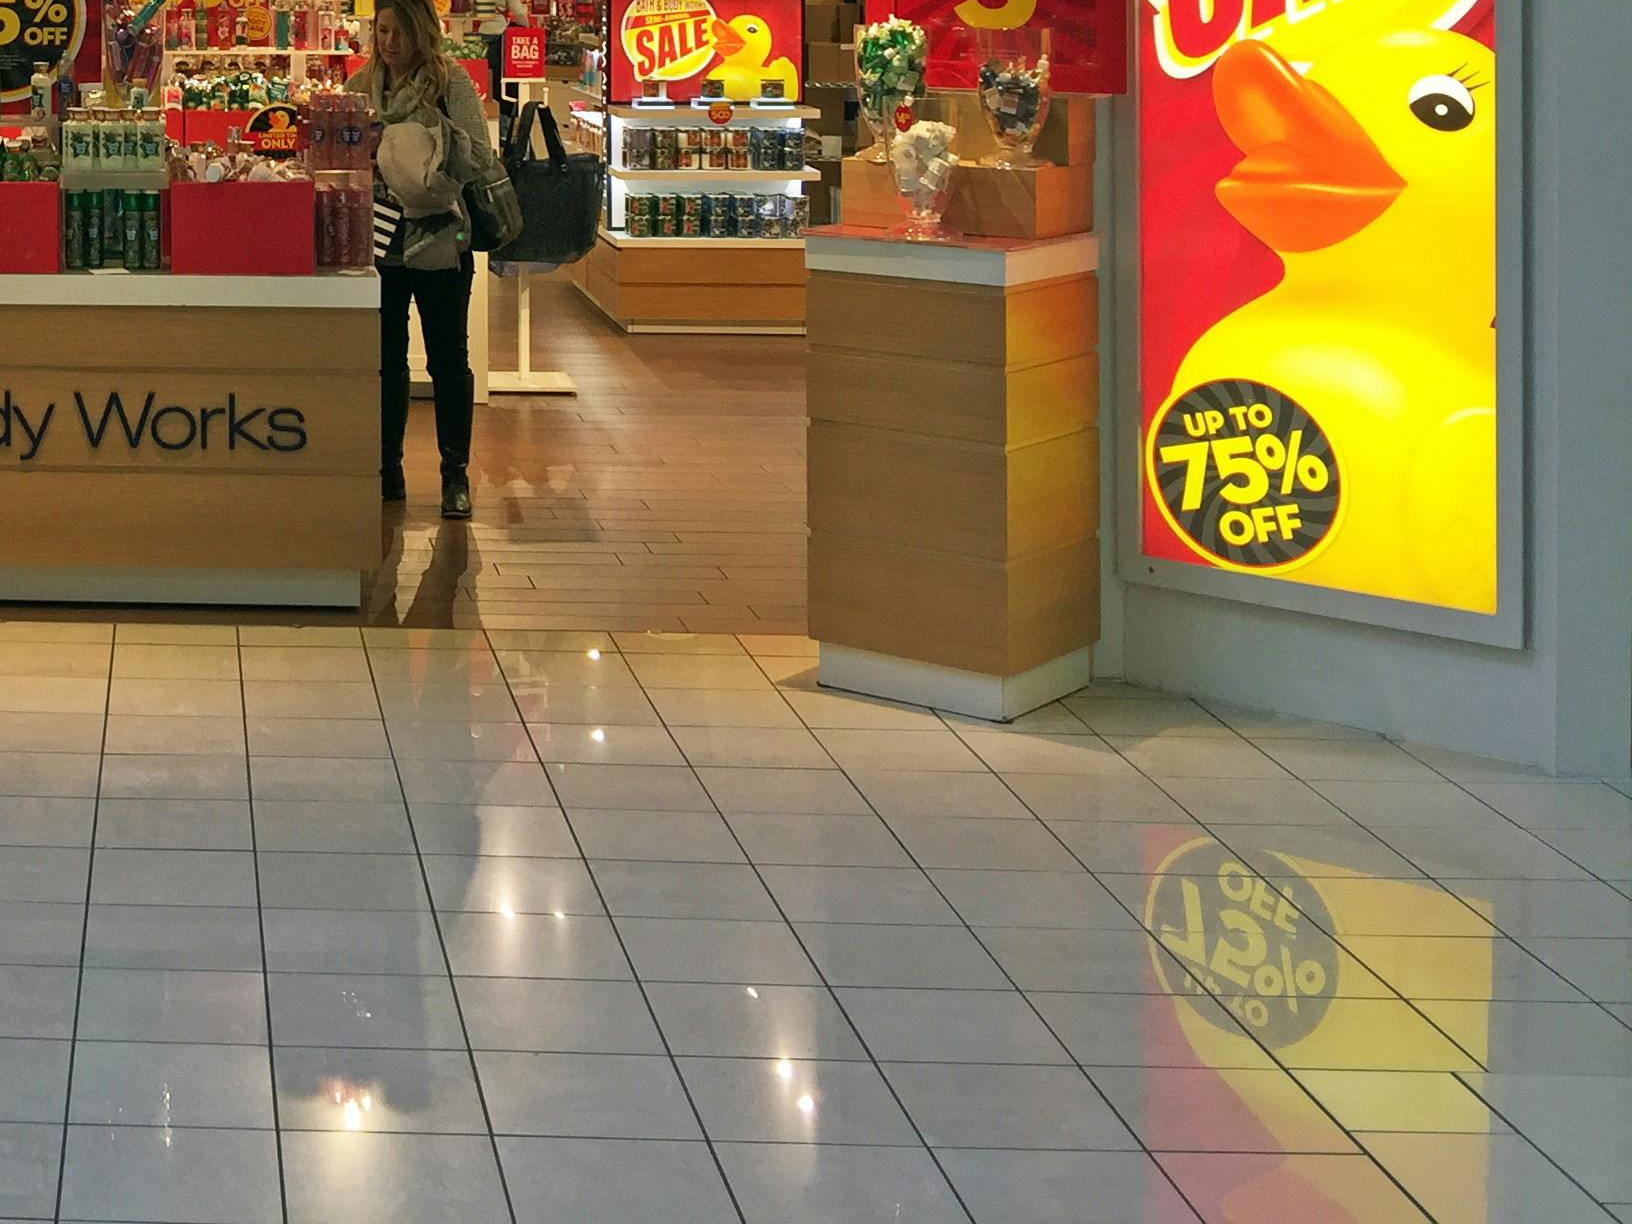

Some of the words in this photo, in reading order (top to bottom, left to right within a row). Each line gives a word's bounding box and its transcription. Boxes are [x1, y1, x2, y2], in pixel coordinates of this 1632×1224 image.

[23, 27, 68, 46] OFF
[511, 45, 539, 59] BAG
[512, 37, 529, 45] TAKE
[532, 37, 538, 45] A
[636, 18, 708, 76] SALE
[74, 391, 307, 452] Works
[1184, 411, 1224, 437] UP
[1229, 403, 1272, 431] TO
[1160, 430, 1328, 511] 75%
[1219, 504, 1302, 546] OFF
